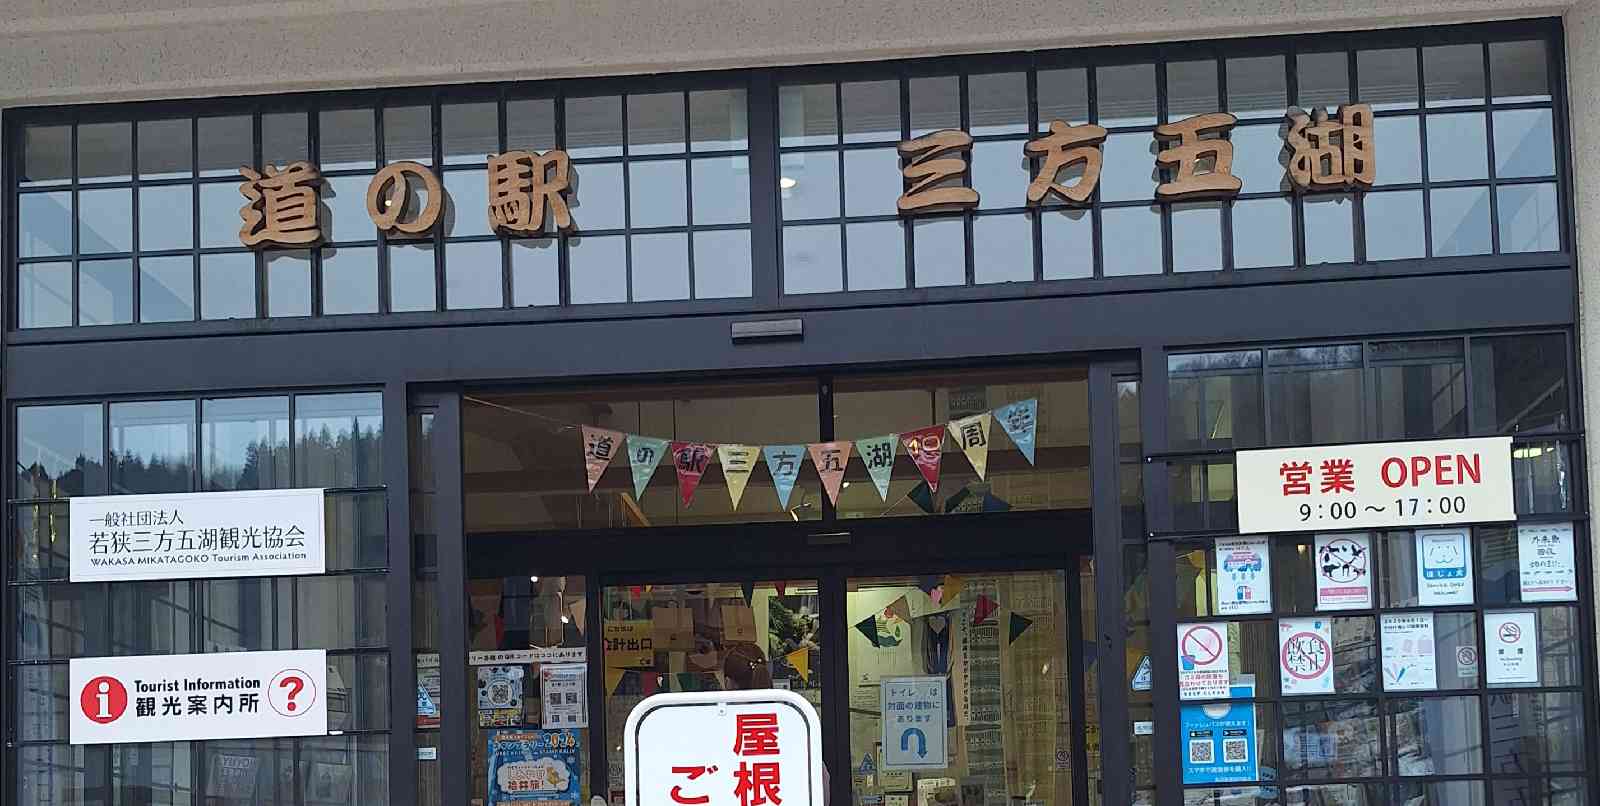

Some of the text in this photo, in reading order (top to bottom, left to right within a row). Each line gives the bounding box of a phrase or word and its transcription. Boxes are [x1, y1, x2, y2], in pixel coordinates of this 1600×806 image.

[239, 104, 1375, 247] 道の駅 三方五湖
[1280, 453, 1482, 496] 営業 OPEN
[88, 510, 184, 527] 一般社団法人
[88, 524, 305, 555] 若狭三方五湖観光協会
[90, 551, 307, 567] WAKASA MIKATAGOKO Tourism Association
[134, 677, 261, 693] Tourist Information
[135, 693, 260, 718] 観光案内所
[733, 713, 783, 806] 屋根
[670, 765, 718, 804] ご
